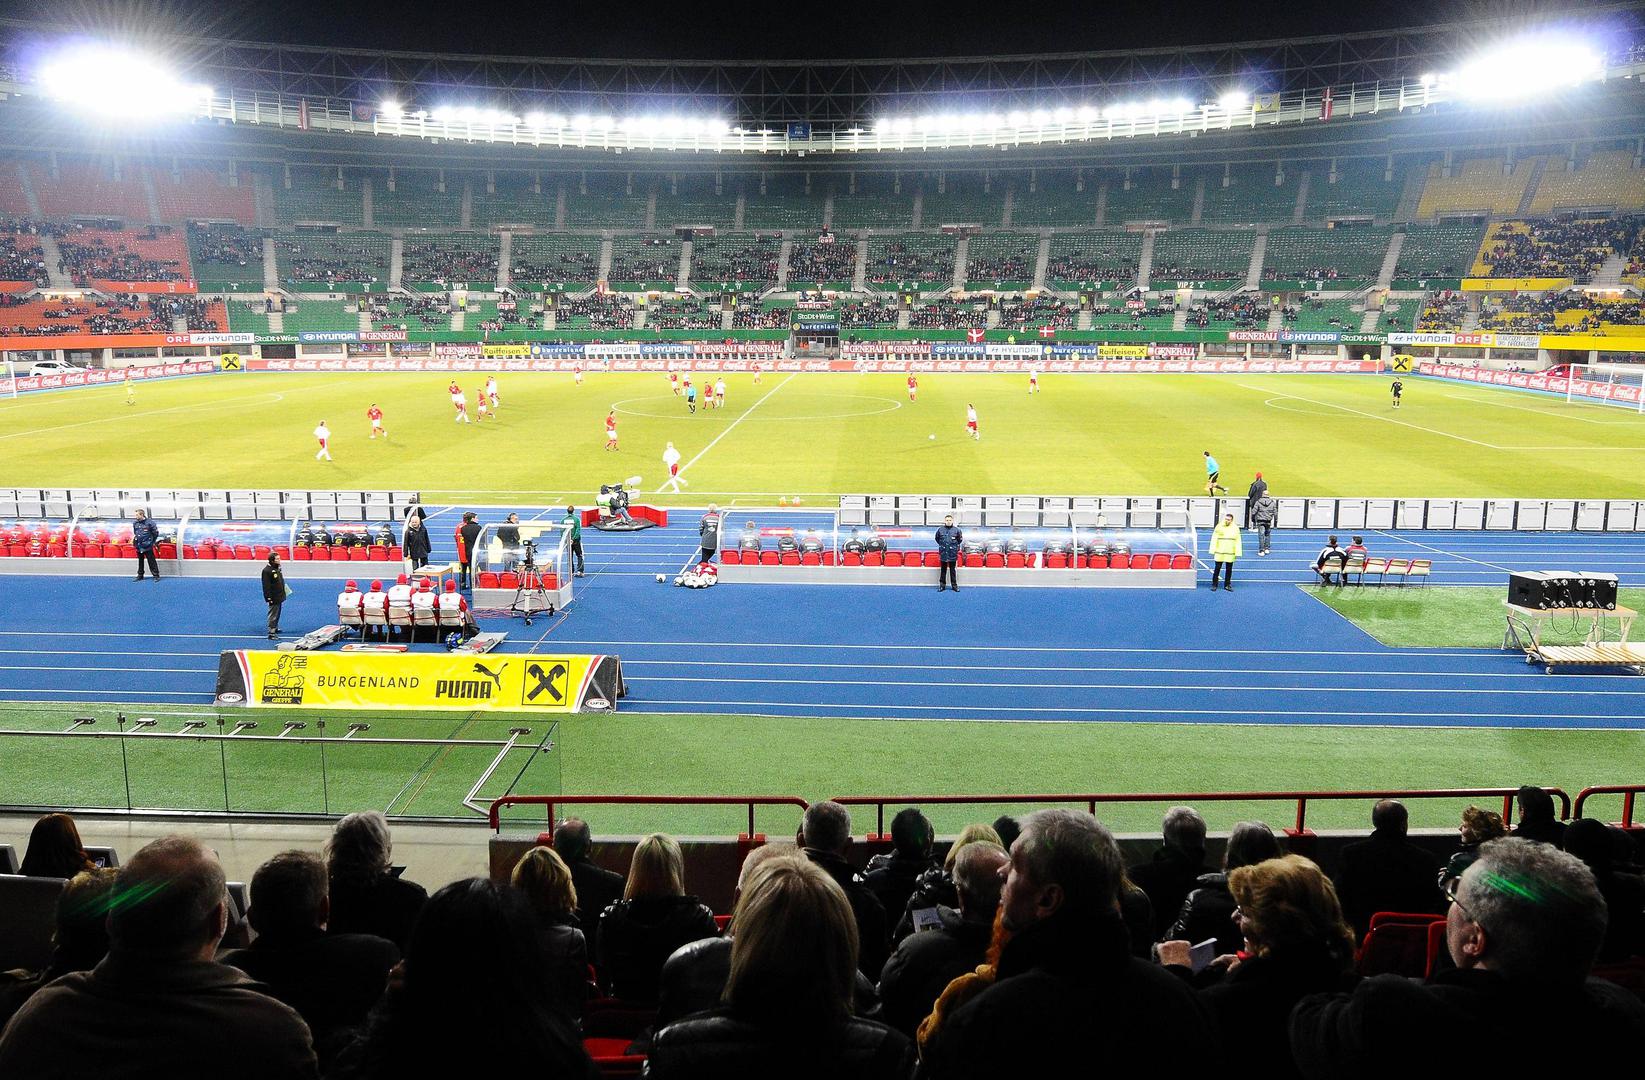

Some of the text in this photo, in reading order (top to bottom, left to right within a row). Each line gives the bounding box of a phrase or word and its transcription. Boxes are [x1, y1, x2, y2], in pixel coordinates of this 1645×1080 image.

[1236, 332, 1278, 340] GENERALI
[443, 346, 480, 355] GENERALI
[484, 347, 521, 356] Raiffeisen
[894, 345, 930, 353] GENERALI
[1099, 347, 1136, 356] Raiffeisen
[1154, 347, 1195, 356] GENERALI
[317, 676, 420, 688] BURGENLAND
[264, 688, 302, 698] GENERALI
[436, 682, 492, 700] PUMA
